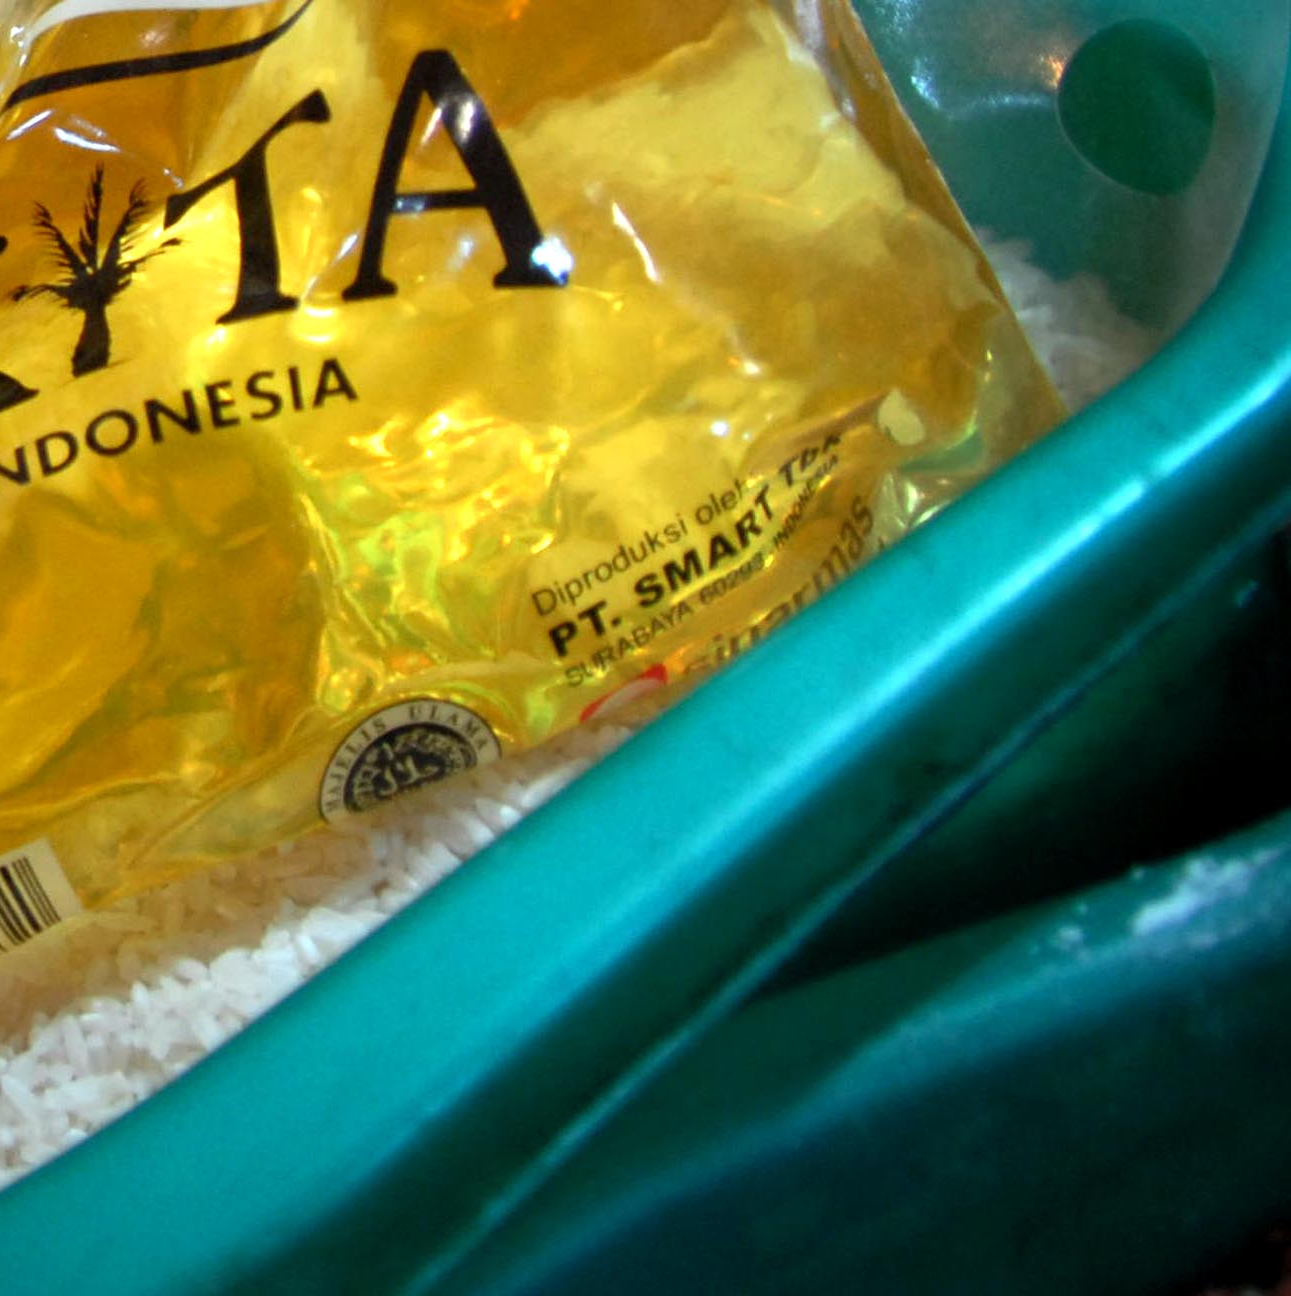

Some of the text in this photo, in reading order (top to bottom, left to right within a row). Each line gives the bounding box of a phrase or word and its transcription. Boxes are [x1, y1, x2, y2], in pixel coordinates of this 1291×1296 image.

[531, 510, 689, 618] Diproduksi
[548, 600, 623, 659] PT.
[634, 485, 775, 609] SMART
[564, 604, 694, 689] SURABAYA
[408, 704, 489, 751] ULAMA
